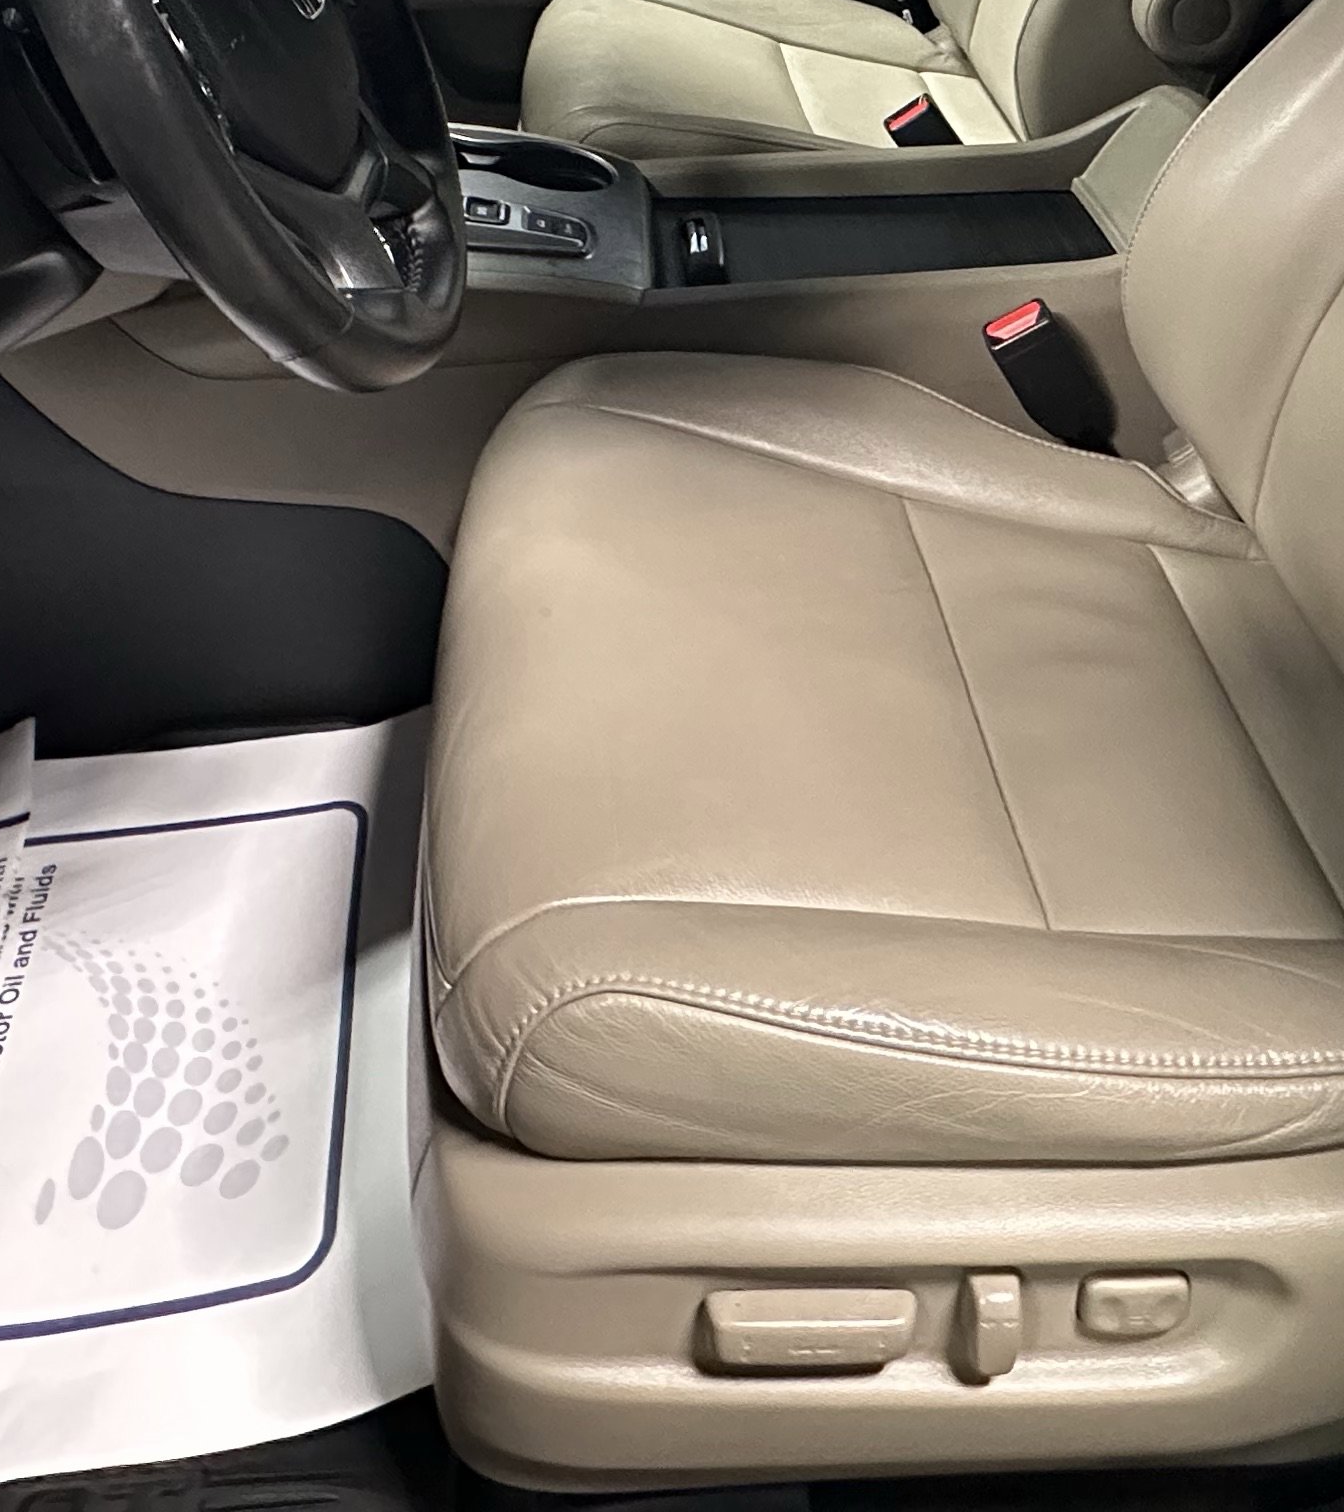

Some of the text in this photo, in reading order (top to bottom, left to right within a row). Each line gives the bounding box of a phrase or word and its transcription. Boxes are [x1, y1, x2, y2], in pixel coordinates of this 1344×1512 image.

[23, 864, 57, 923] Fluids
[14, 929, 37, 968] and
[0, 975, 25, 1005] Oil
